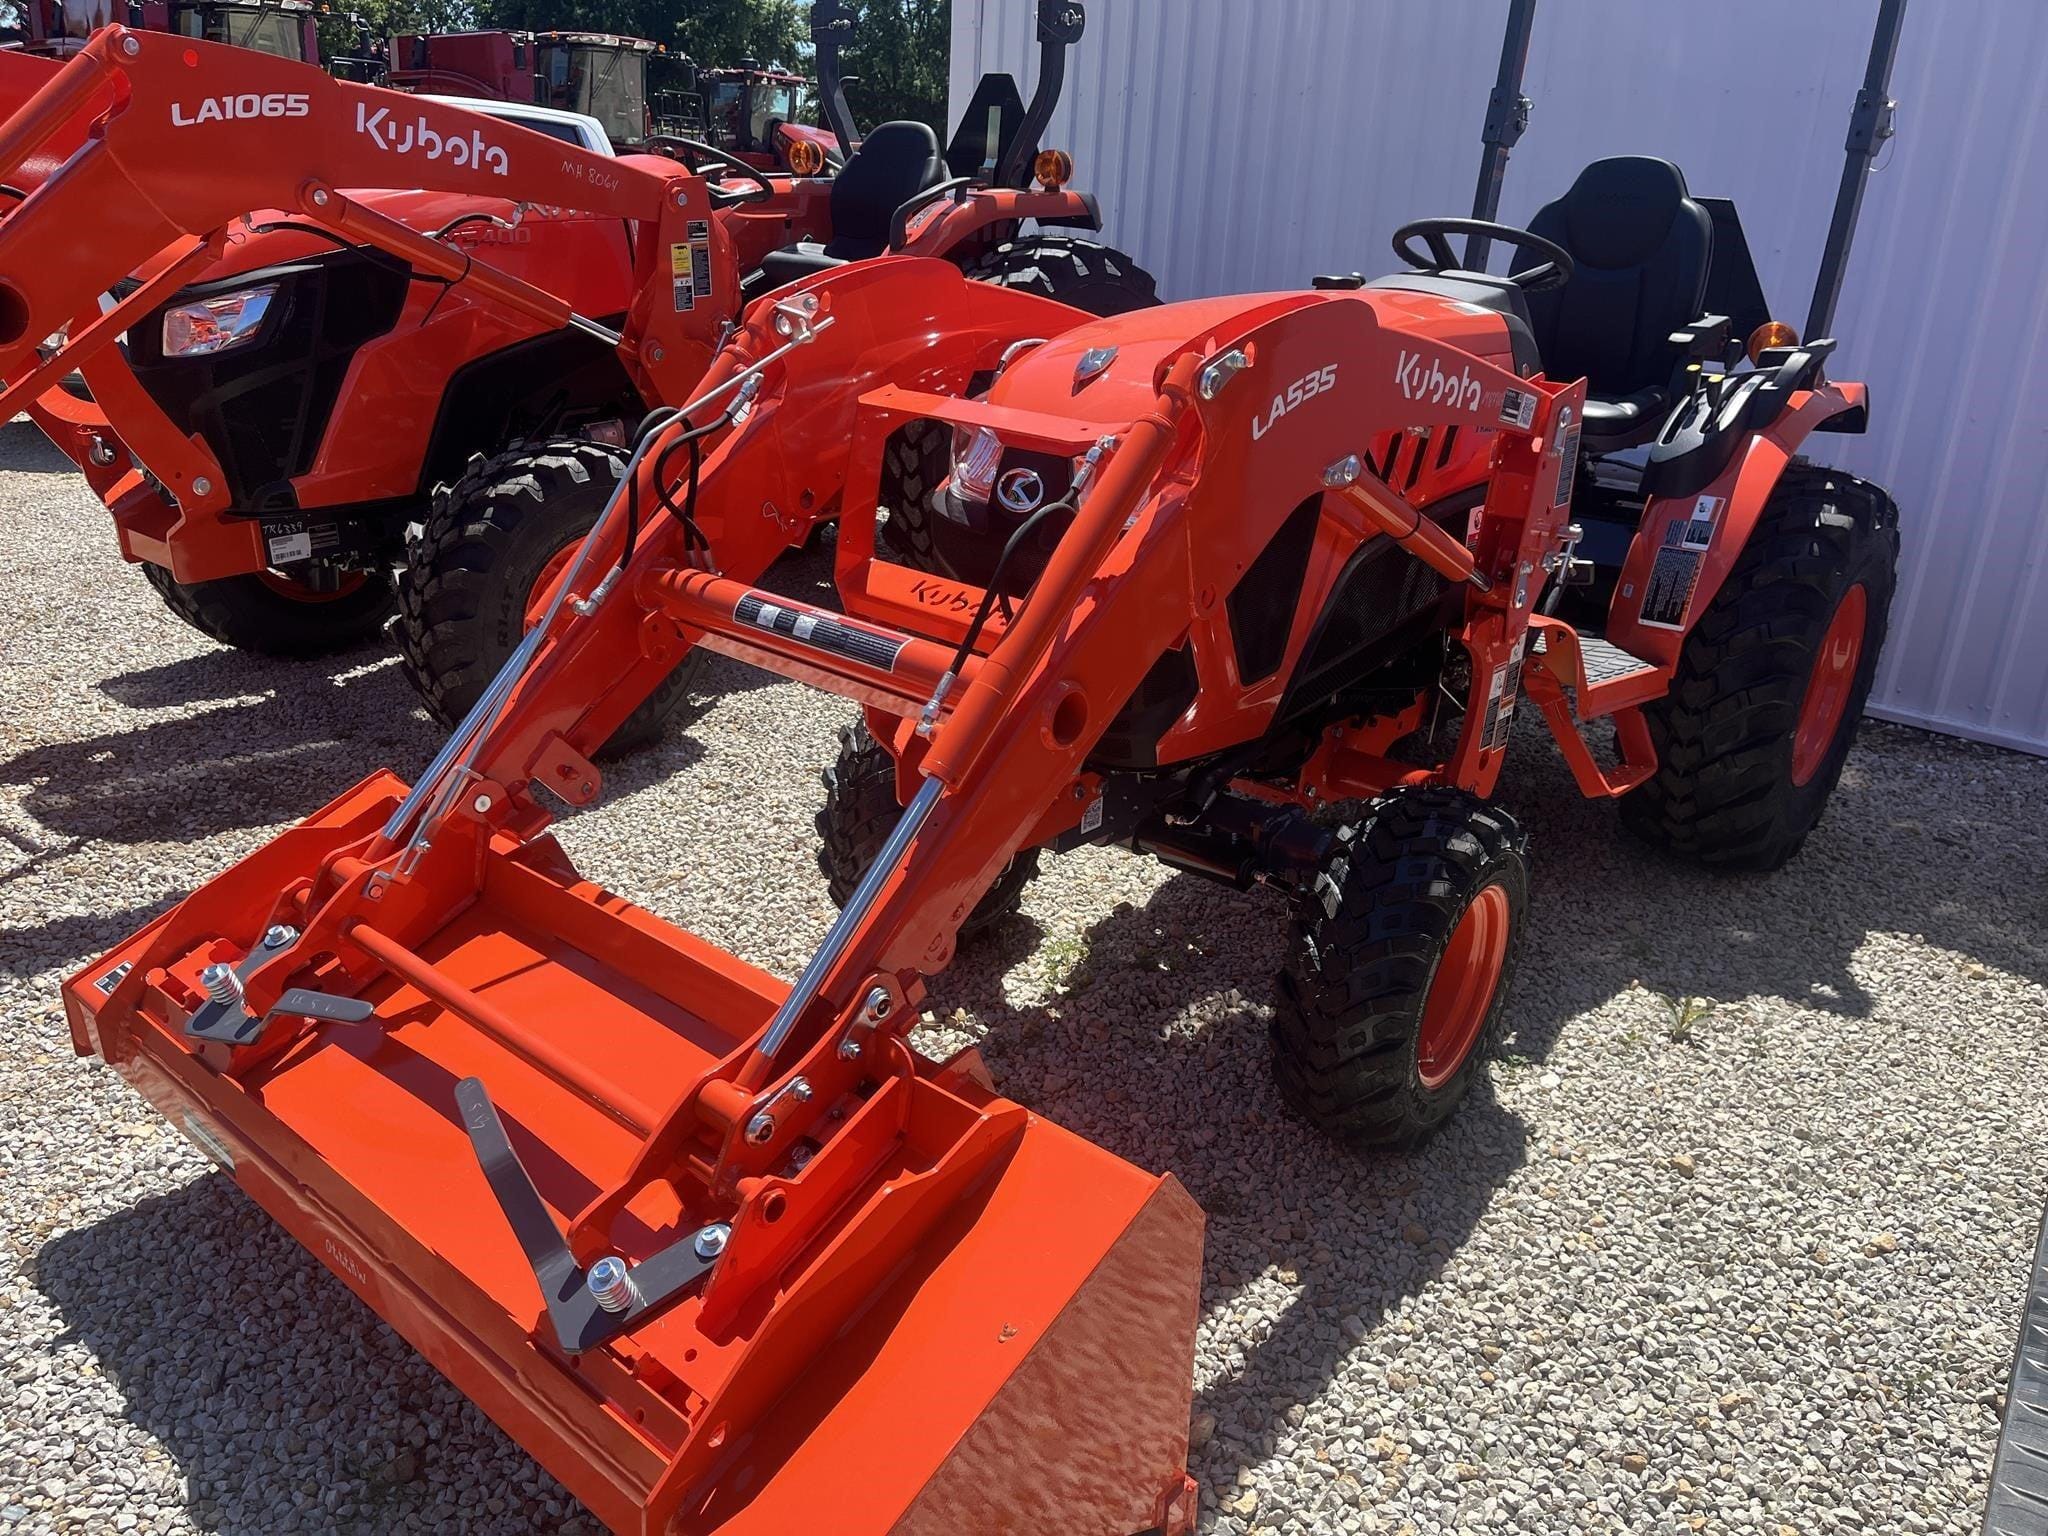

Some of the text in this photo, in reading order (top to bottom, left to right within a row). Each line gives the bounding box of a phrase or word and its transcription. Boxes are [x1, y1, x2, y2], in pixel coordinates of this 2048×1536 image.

[171, 93, 310, 127] LA1065
[356, 102, 509, 176] Kubota
[588, 168, 620, 193] 8064
[1252, 363, 1338, 441] LA535
[1395, 350, 1482, 412] Kubota
